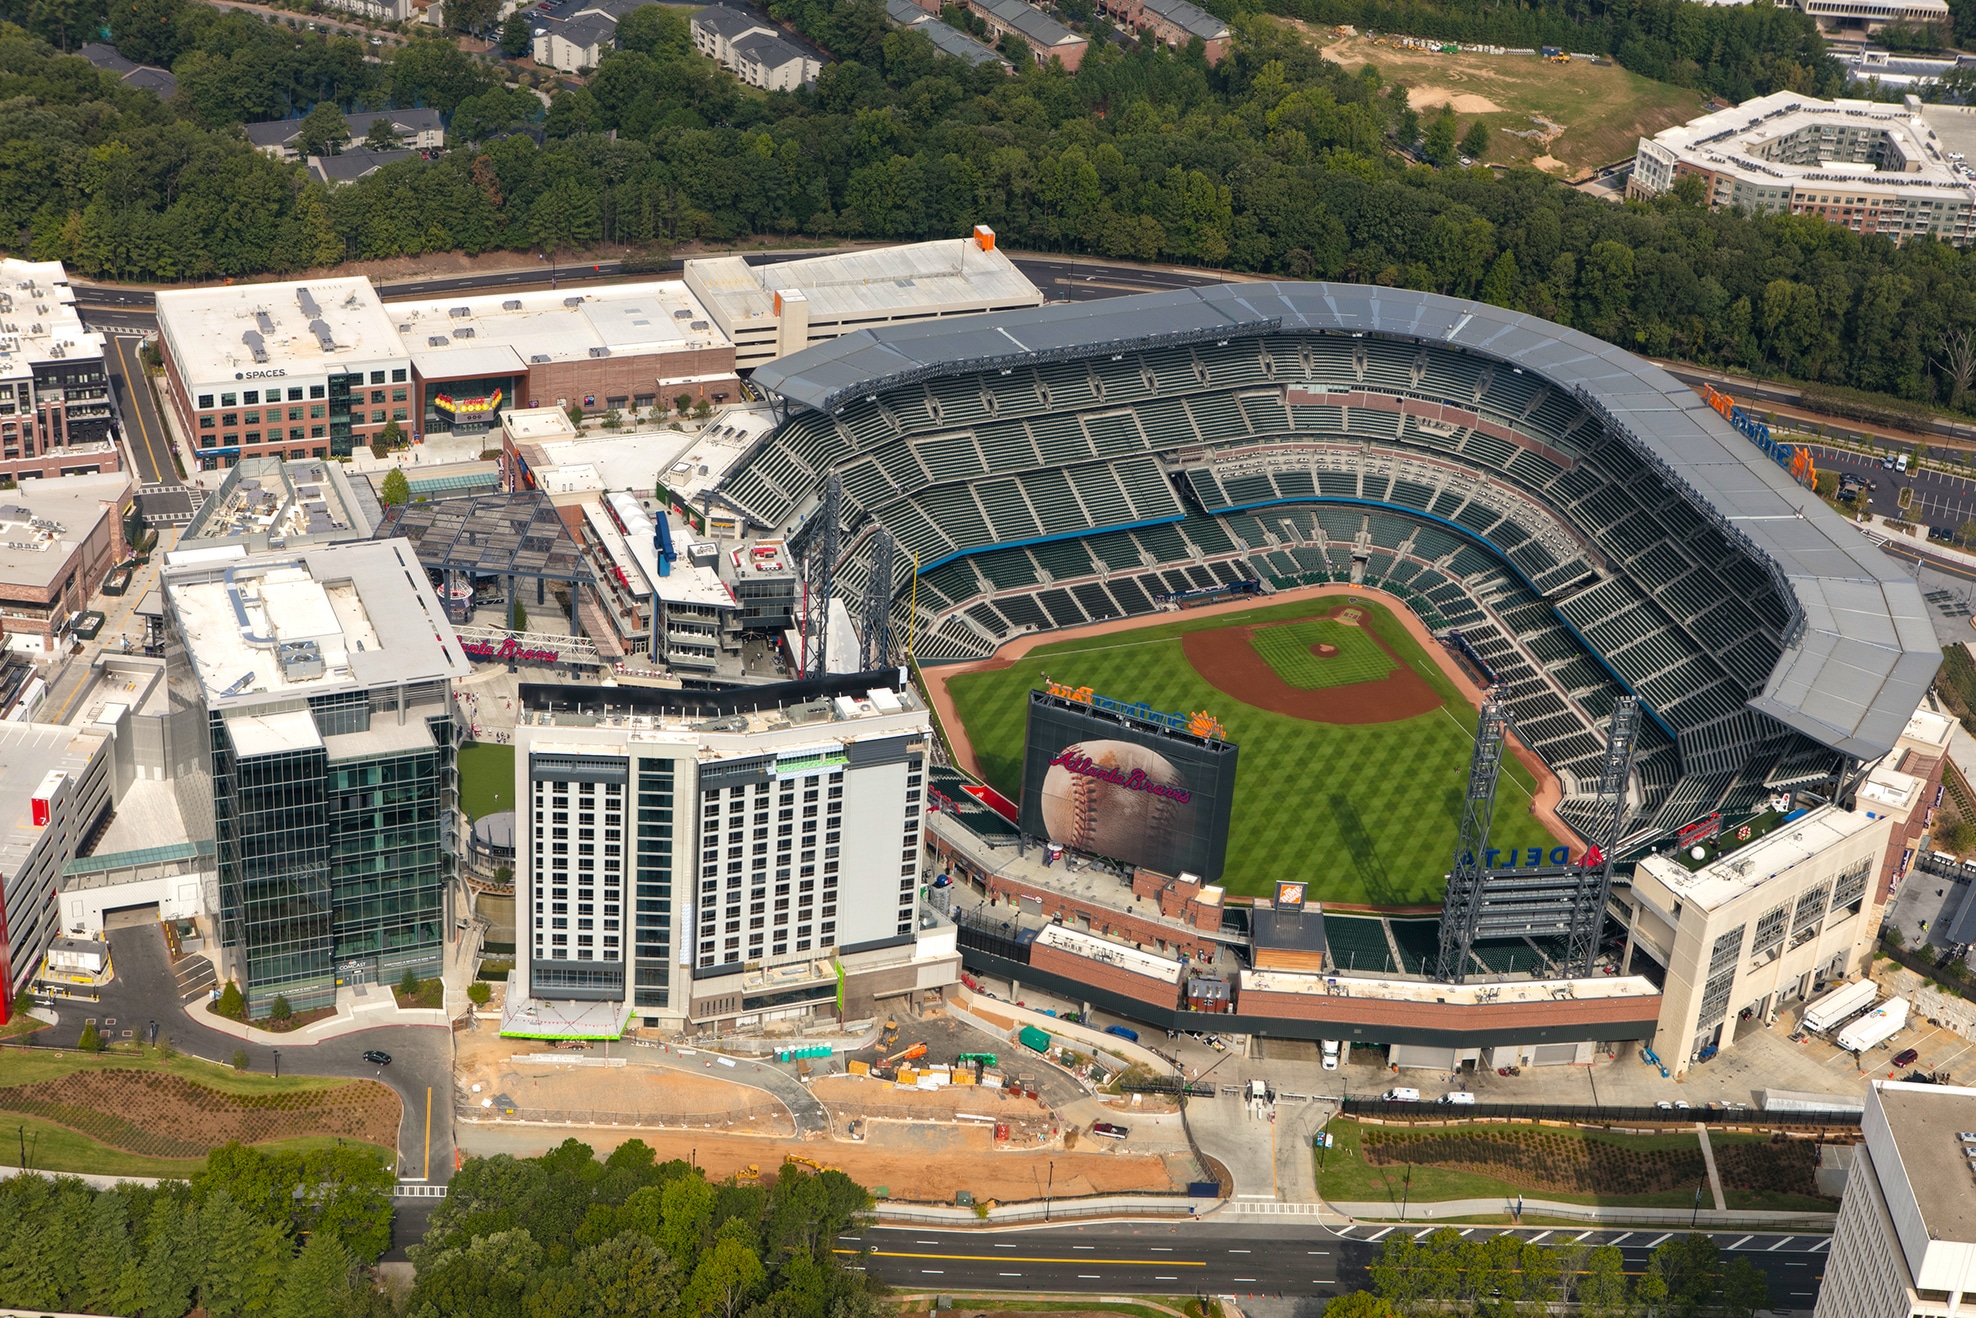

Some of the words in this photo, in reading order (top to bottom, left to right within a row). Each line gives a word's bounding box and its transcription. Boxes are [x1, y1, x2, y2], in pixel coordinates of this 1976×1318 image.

[497, 637, 560, 663] Braves
[1049, 751, 1127, 786] Atlanta
[1123, 768, 1191, 804] Braves
[40, 816, 47, 825] 7
